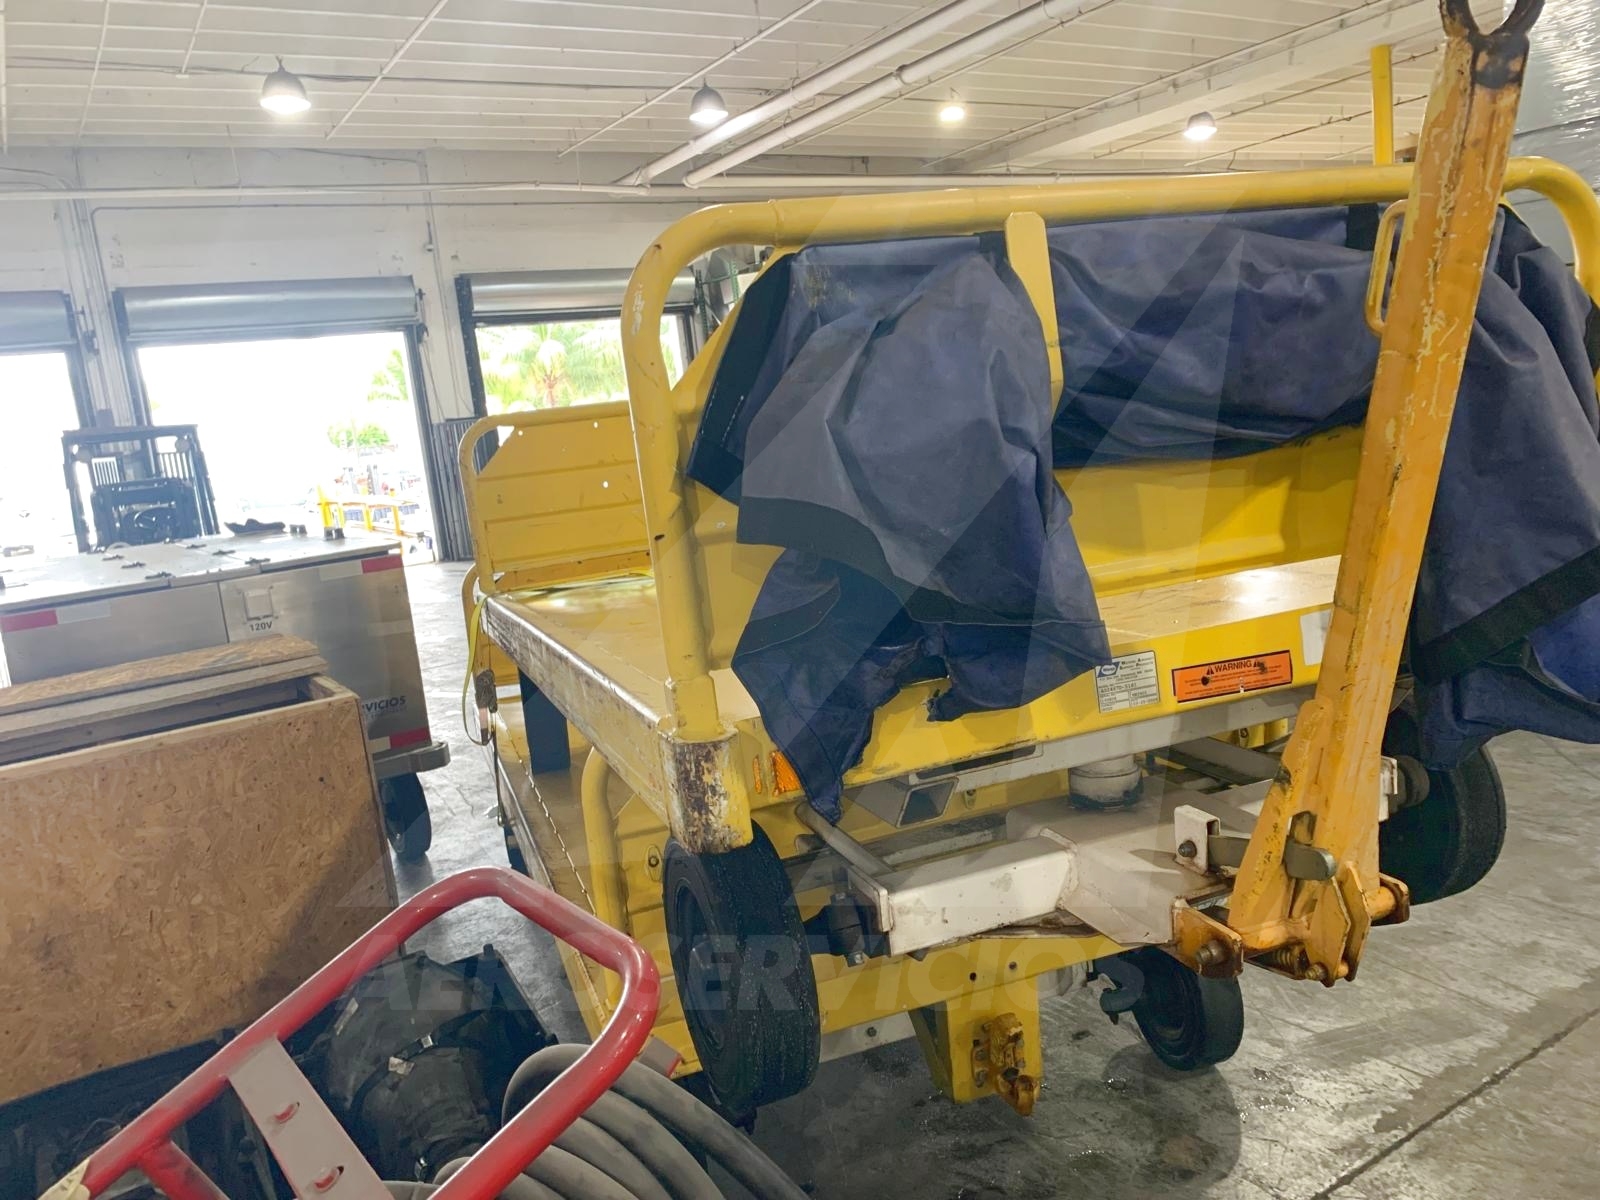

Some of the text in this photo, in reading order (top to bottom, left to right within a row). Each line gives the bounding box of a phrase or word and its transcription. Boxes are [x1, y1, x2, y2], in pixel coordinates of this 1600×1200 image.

[250, 621, 273, 632] 120V
[1214, 660, 1253, 673] WARNING
[362, 696, 406, 712] VICIOS
